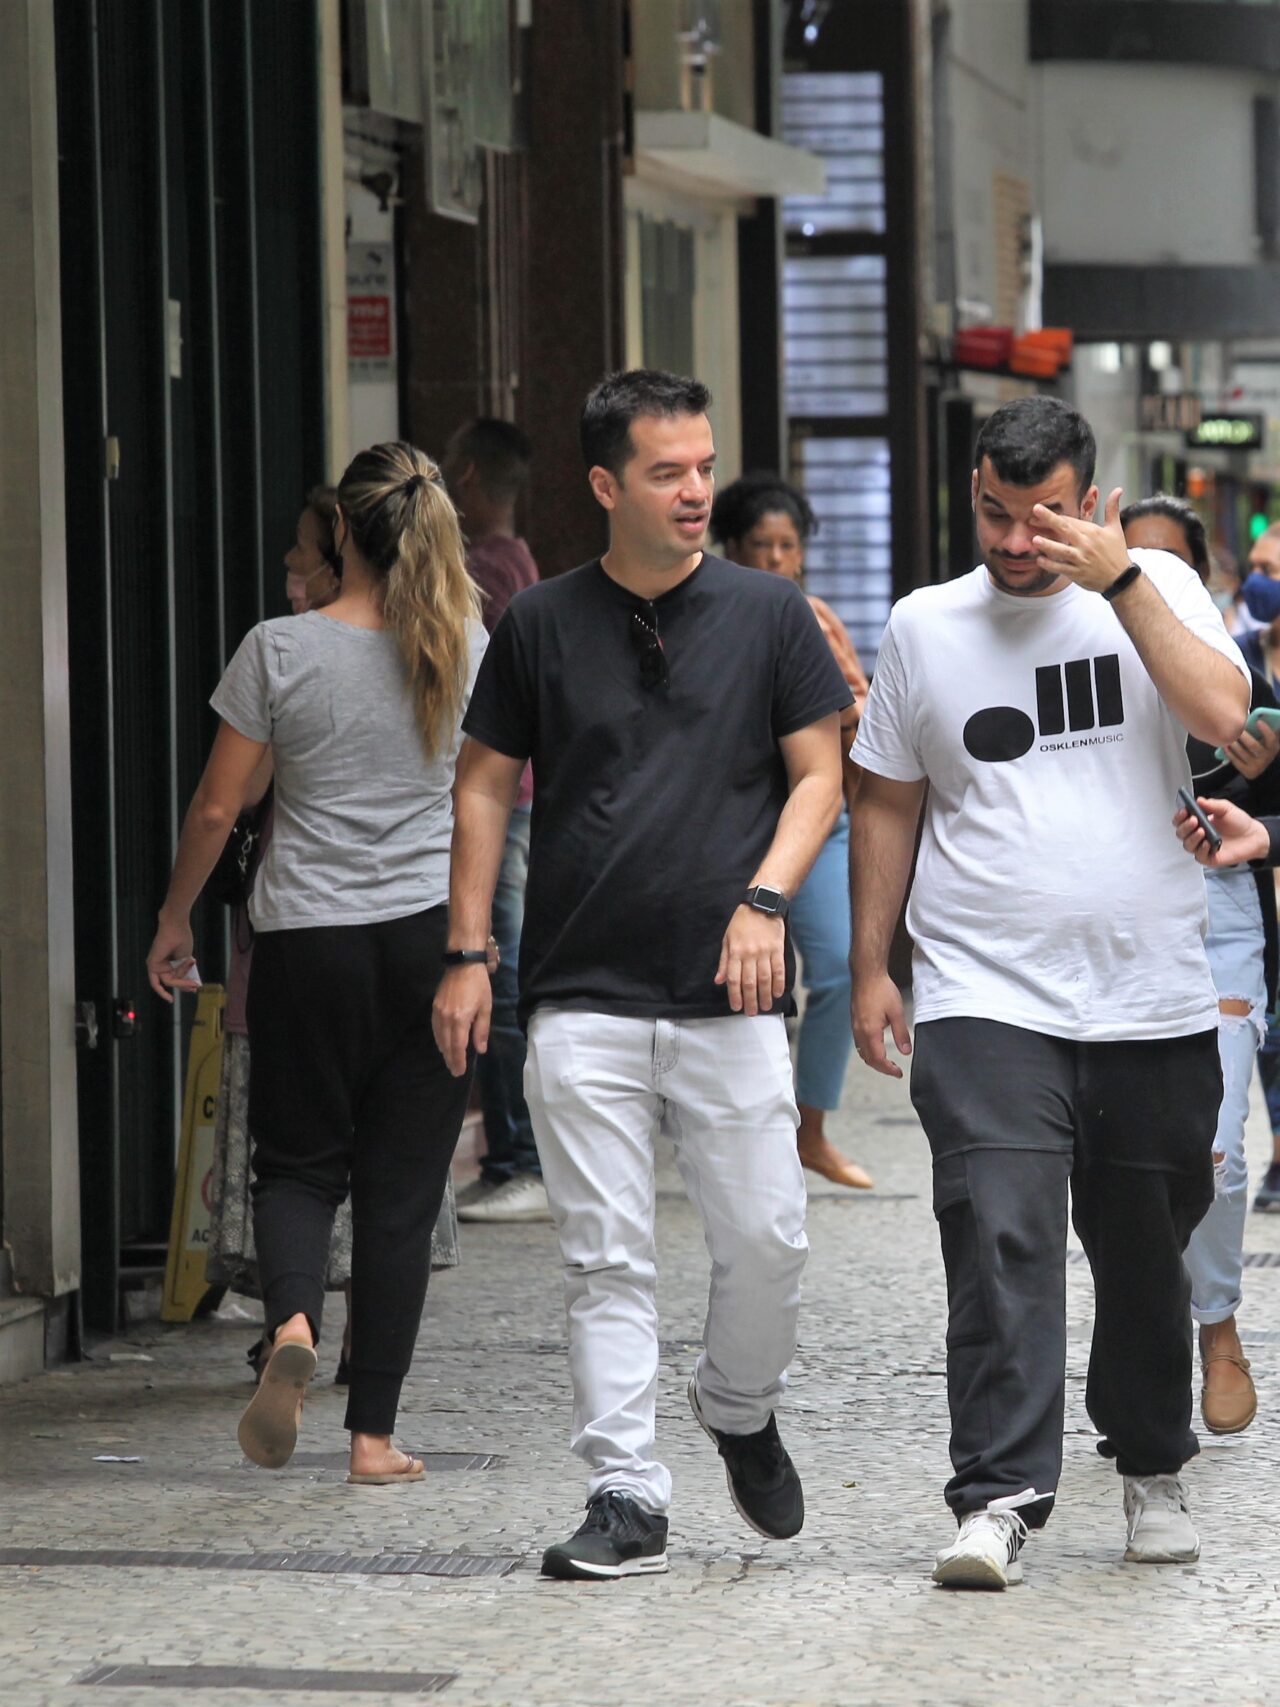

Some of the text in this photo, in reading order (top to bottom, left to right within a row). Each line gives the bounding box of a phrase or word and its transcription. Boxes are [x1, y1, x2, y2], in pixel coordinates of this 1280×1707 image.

[1039, 733, 1124, 752] OSKLENMUSIC
[203, 1095, 215, 1119] C
[192, 1229, 210, 1243] AC
